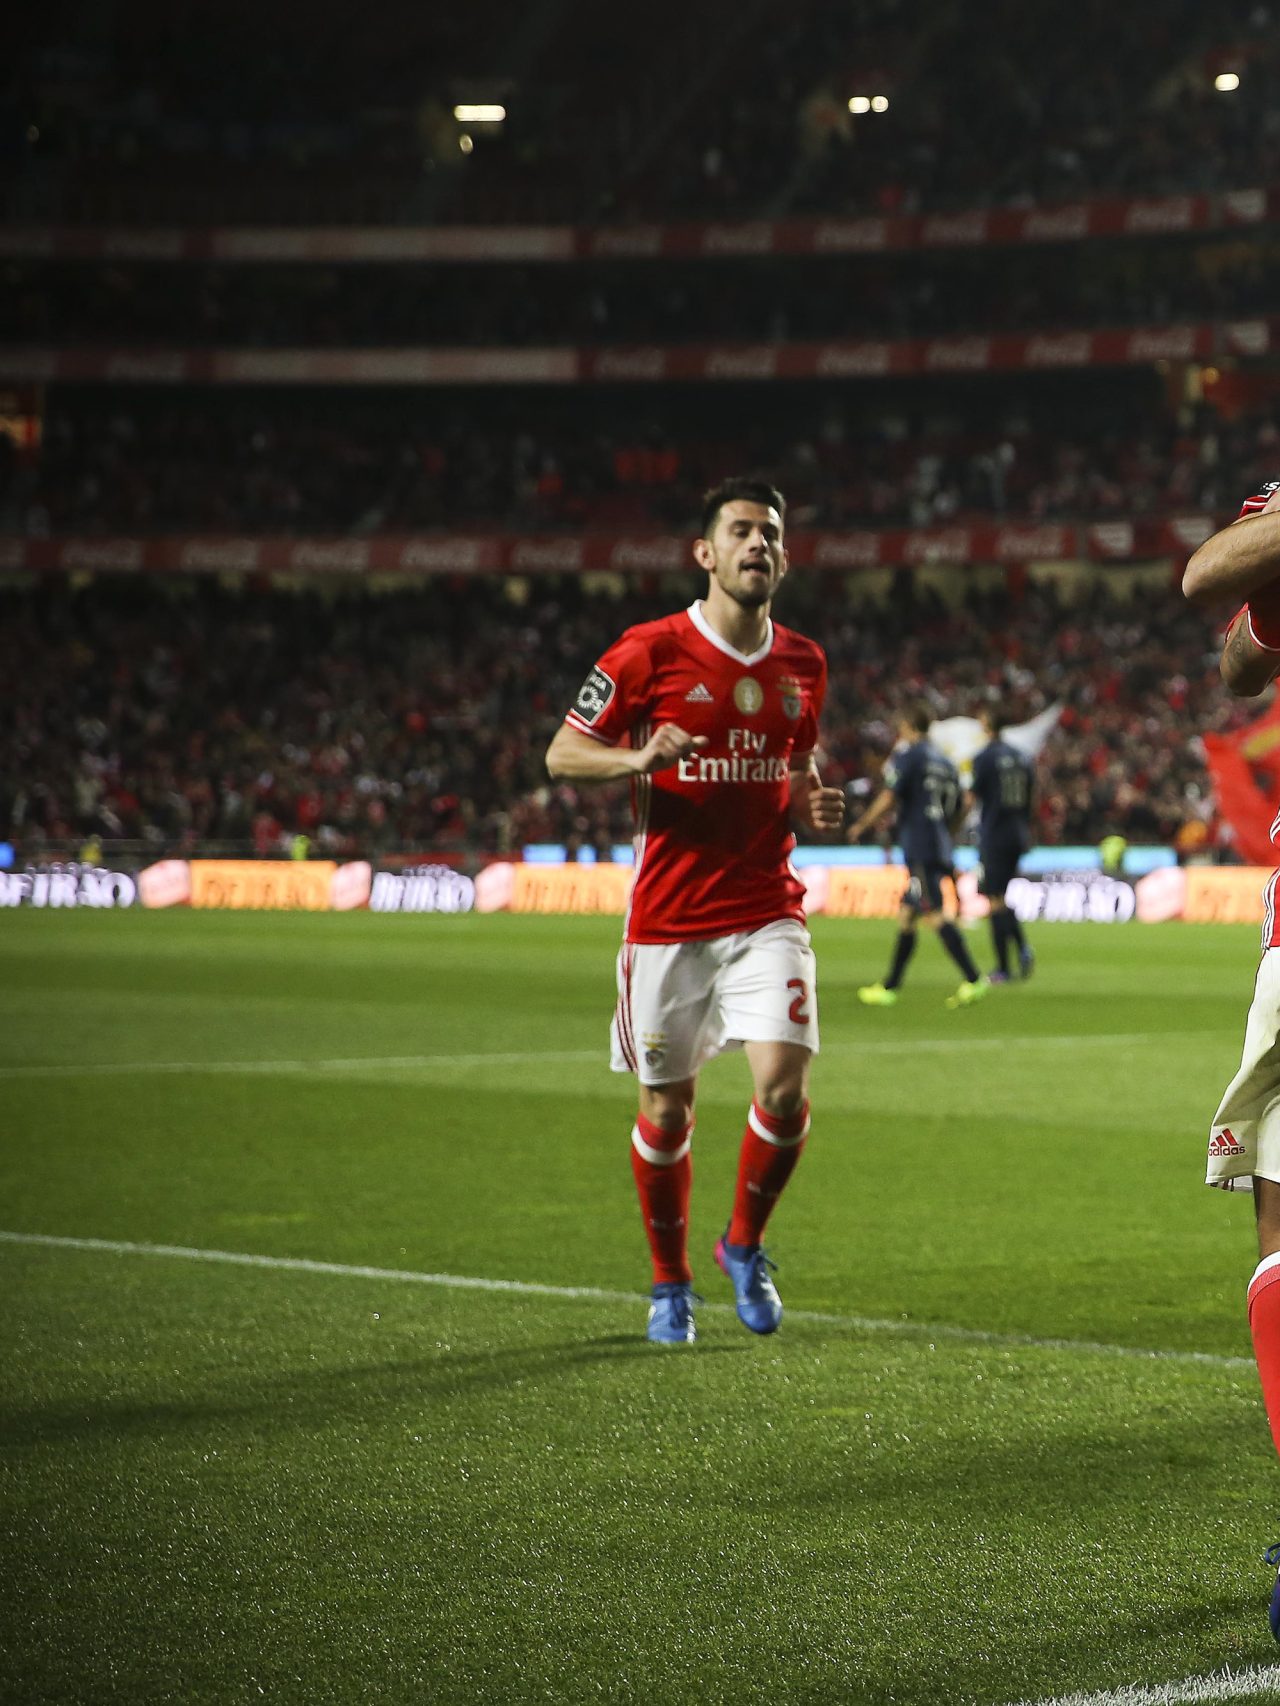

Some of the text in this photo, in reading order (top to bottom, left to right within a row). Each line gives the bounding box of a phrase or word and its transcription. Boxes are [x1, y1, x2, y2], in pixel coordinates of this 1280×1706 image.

[728, 728, 767, 754] Fly
[678, 750, 788, 783] Emirate
[787, 978, 809, 1025] 2
[1208, 1145, 1246, 1157] adidas
